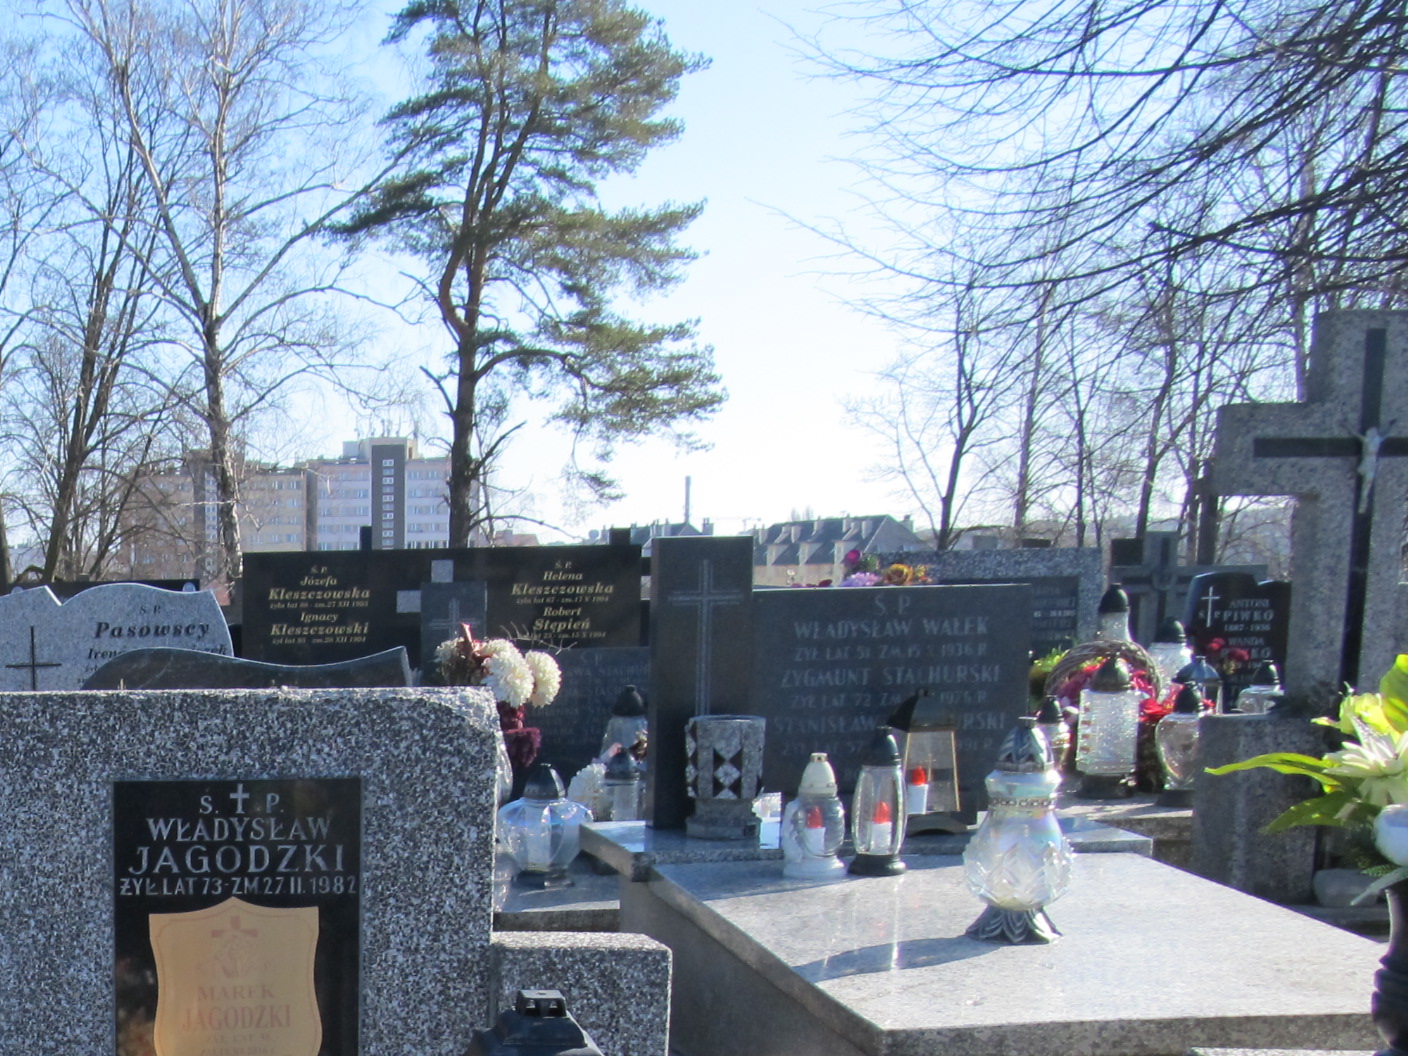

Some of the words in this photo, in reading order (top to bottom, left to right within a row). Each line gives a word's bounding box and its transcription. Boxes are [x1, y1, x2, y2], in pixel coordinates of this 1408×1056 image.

[300, 575, 337, 587] Józefa
[543, 571, 583, 581] Helena
[268, 586, 370, 600] Kleszczowska
[511, 581, 615, 595] Kleszczowska
[300, 612, 339, 623] Ignacy
[543, 606, 582, 617] Robert
[1223, 609, 1274, 621] PIWKO
[95, 621, 210, 640] Pasowscy
[270, 622, 369, 636] Kleszczowski
[533, 618, 591, 633] Stępień
[794, 618, 912, 640] WŁADYSŁAW
[780, 667, 871, 688] ZYGMUNT
[146, 816, 332, 842] WŁADYSŁAW
[128, 843, 345, 875] JAGODZKI
[119, 876, 159, 896] ŻYŁ
[162, 876, 196, 895] LAT
[198, 983, 277, 1002] MAREK
[183, 1004, 291, 1032] JAGODZKI
